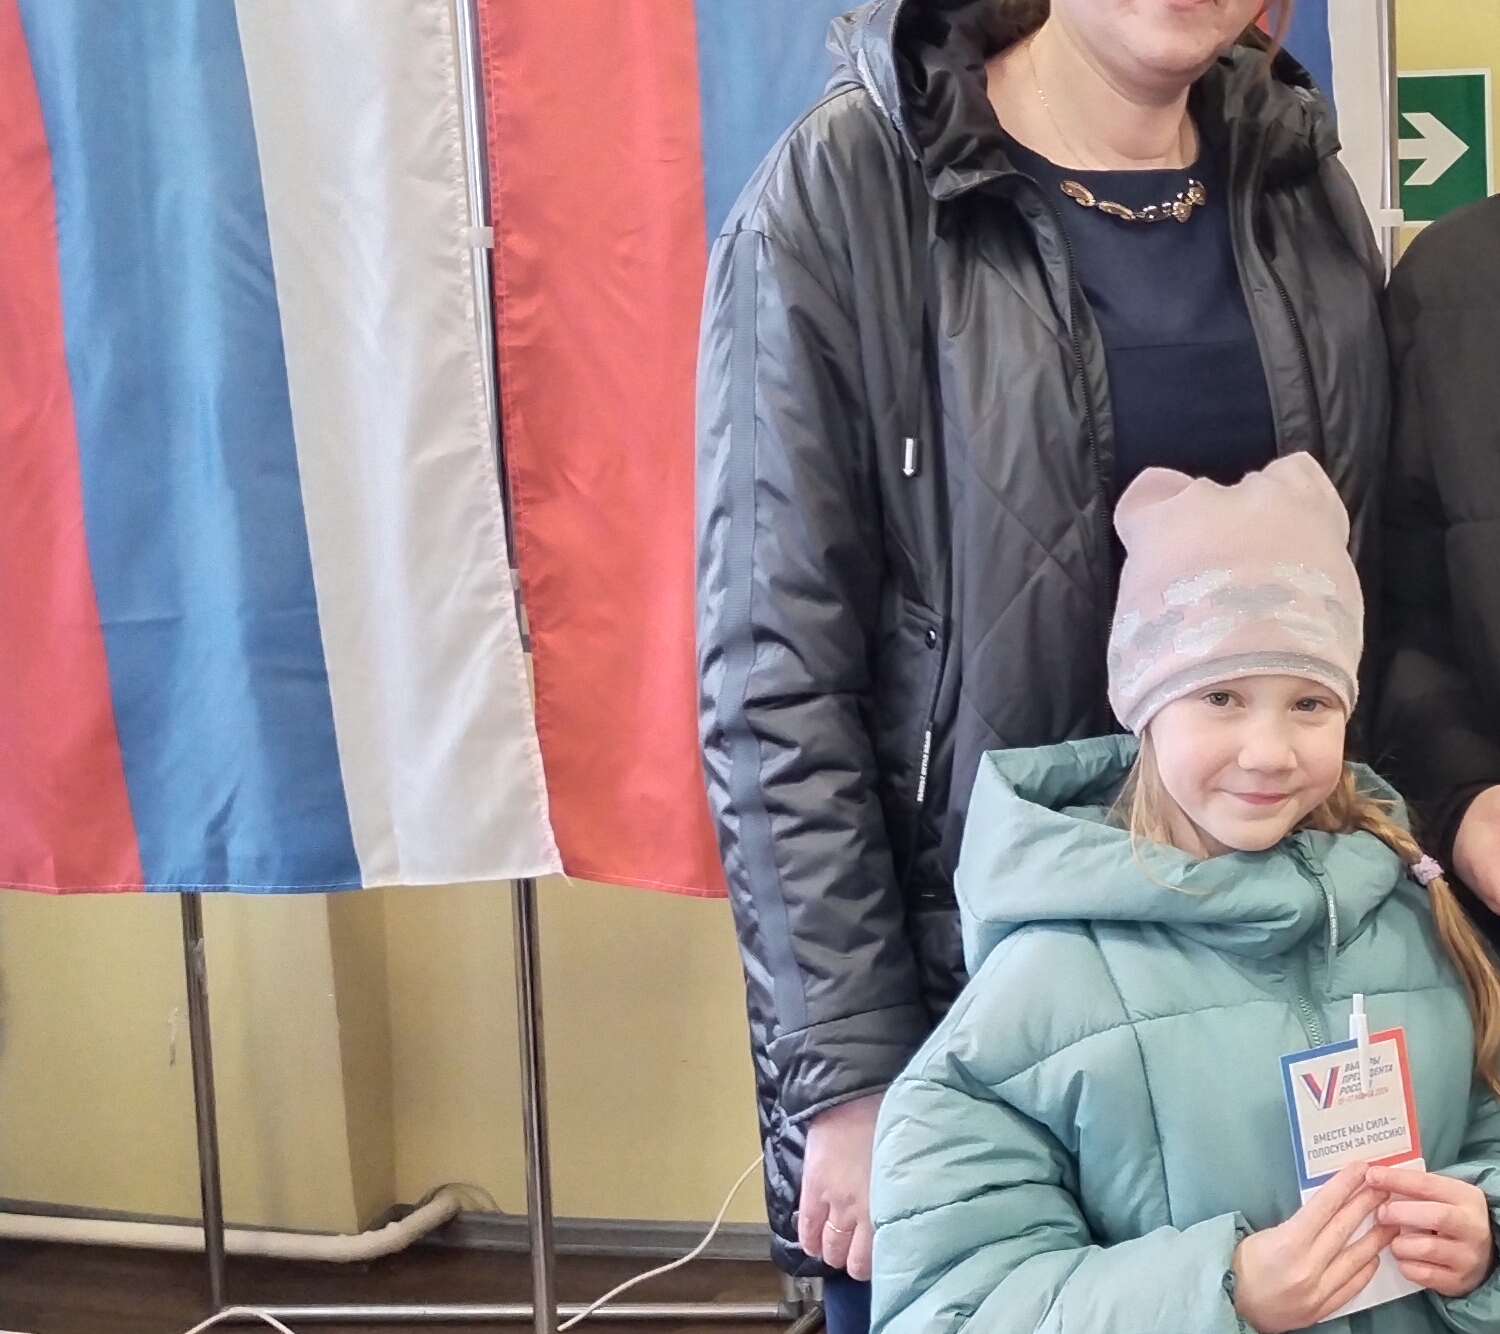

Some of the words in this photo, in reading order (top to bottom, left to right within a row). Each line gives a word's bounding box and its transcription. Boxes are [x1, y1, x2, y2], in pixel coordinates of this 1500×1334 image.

[1307, 1139, 1354, 1161] ГОЛОСУЕМ
[1354, 1136, 1366, 1148] ЗА
[1366, 1125, 1407, 1144] РОССИЮ!
[1312, 1127, 1348, 1145] ВМЕСТЕ
[1348, 1122, 1365, 1136] МЫ
[1365, 1116, 1389, 1131] СИЛА
